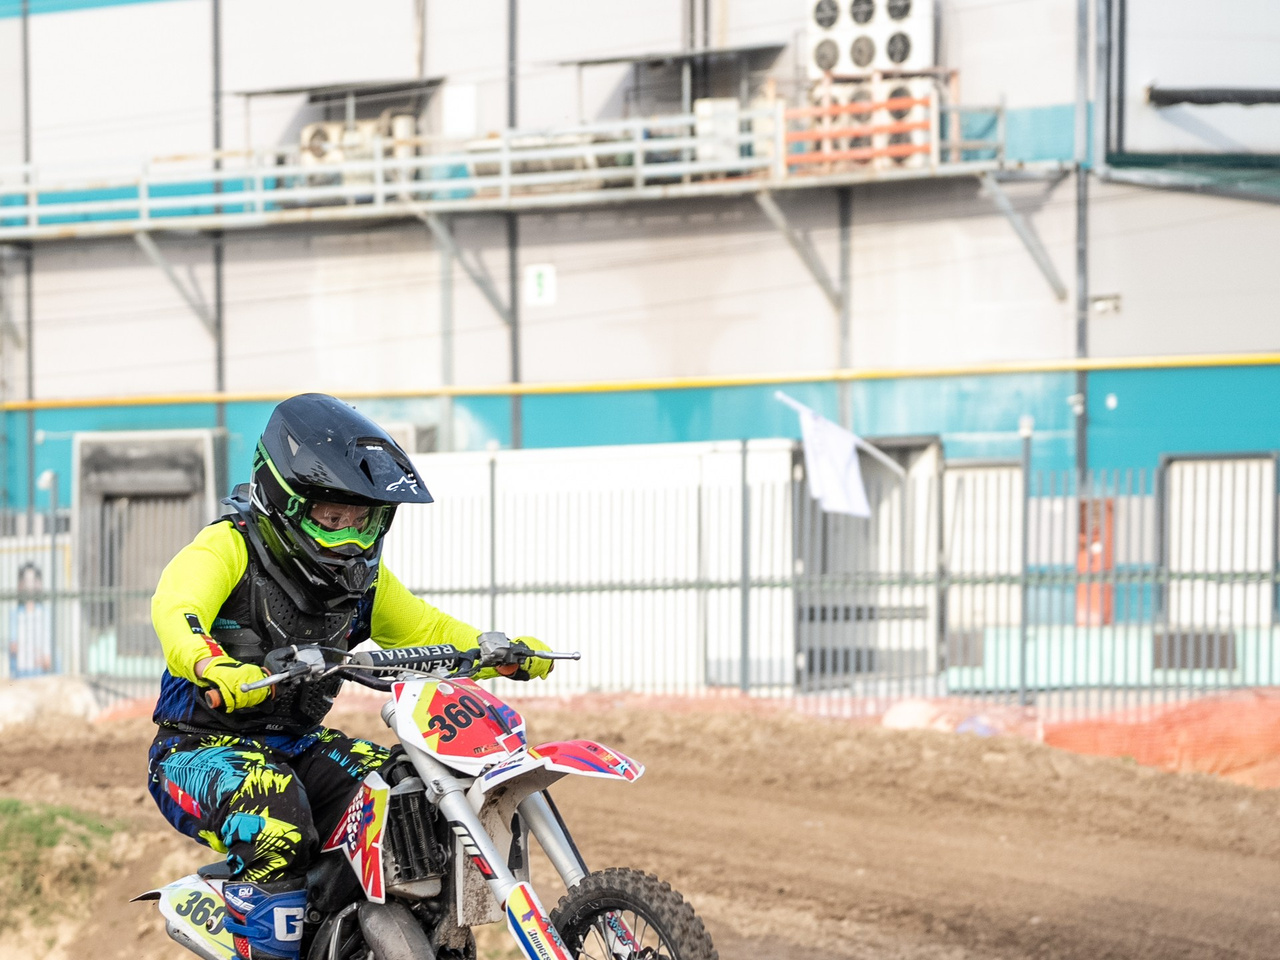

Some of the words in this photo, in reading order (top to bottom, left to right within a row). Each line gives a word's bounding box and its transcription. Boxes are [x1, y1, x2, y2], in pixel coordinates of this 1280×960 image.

[371, 644, 454, 661] RENTHAL
[428, 695, 486, 743] 360
[175, 890, 226, 936] 360
[273, 907, 305, 942] G
